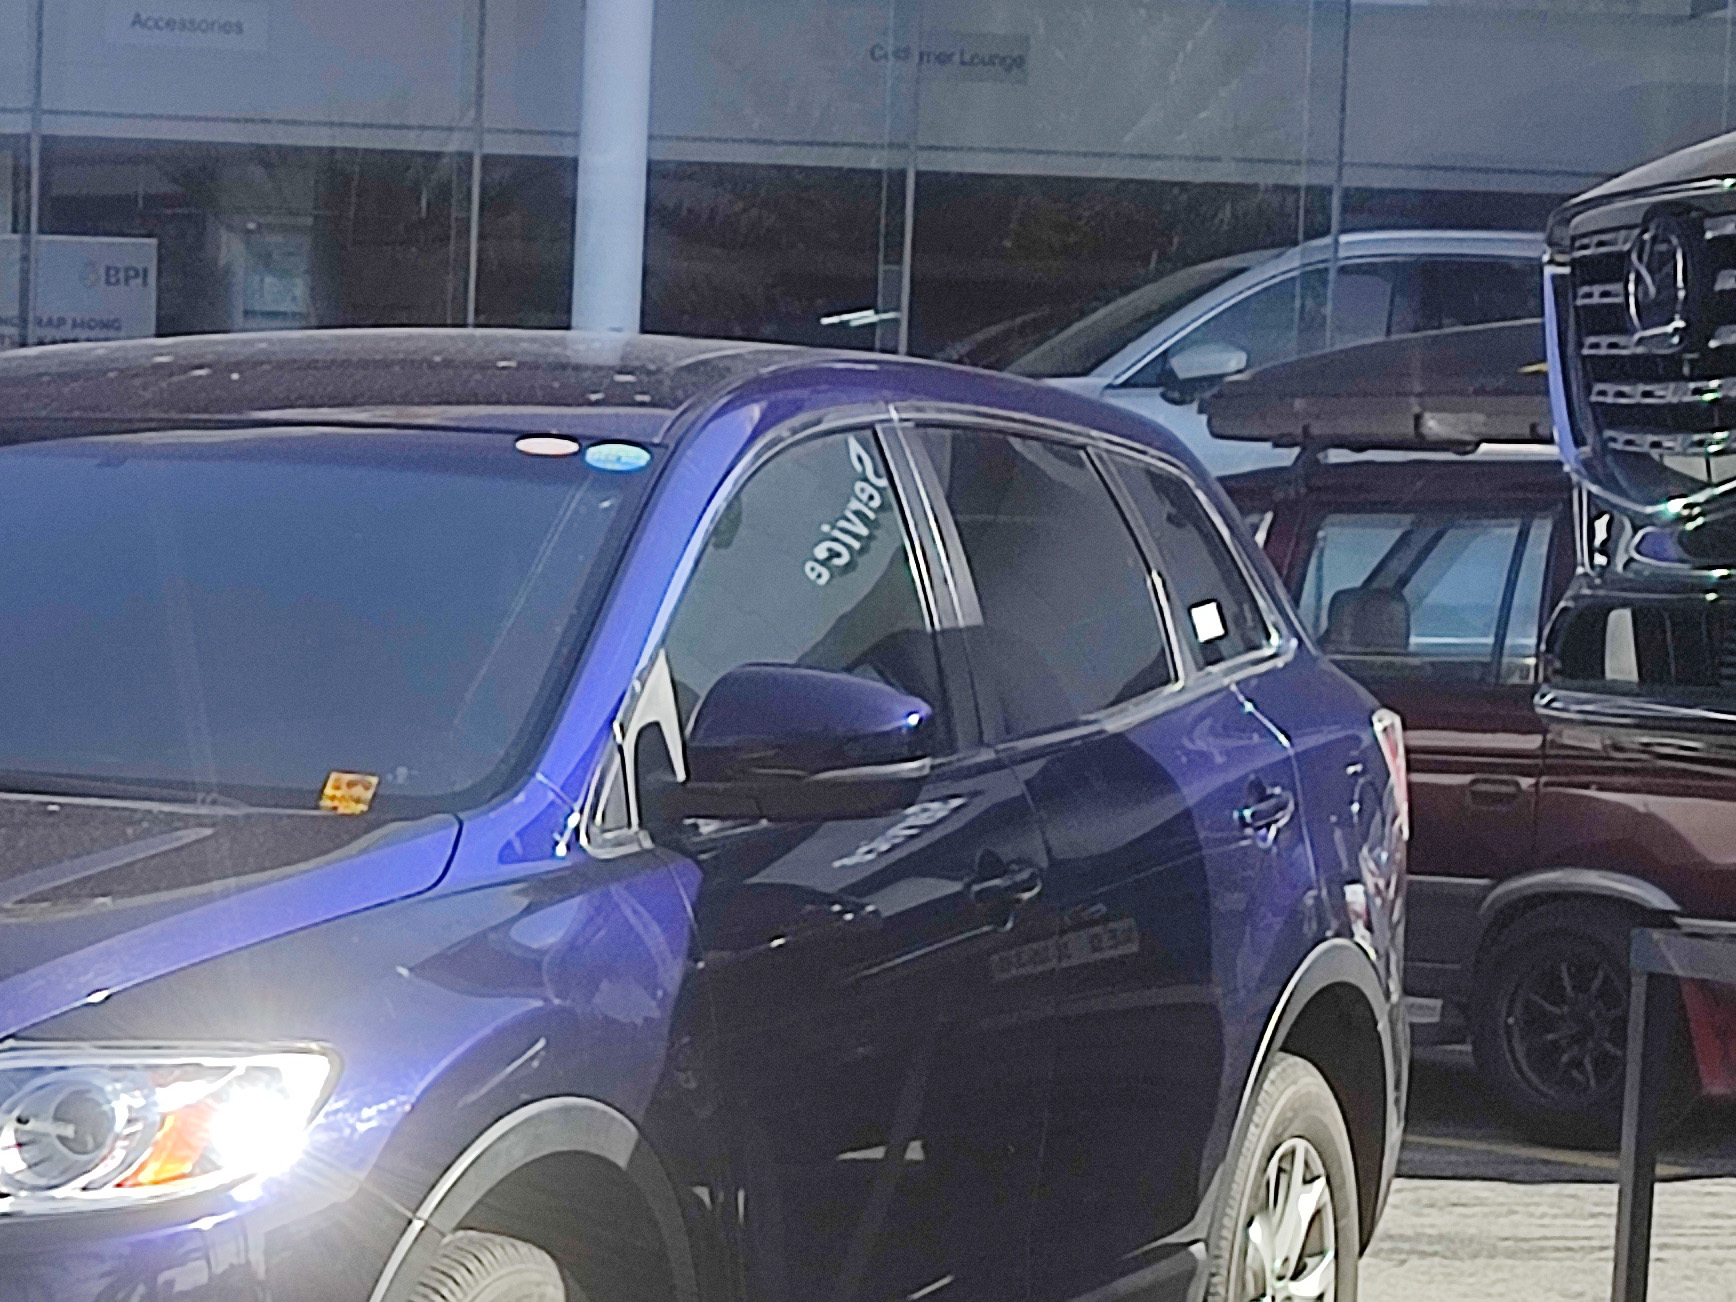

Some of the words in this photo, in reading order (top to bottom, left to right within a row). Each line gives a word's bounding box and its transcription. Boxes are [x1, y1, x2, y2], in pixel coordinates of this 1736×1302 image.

[130, 11, 244, 35] Accessories
[958, 48, 1027, 73] Lounge
[104, 264, 149, 287] BPI
